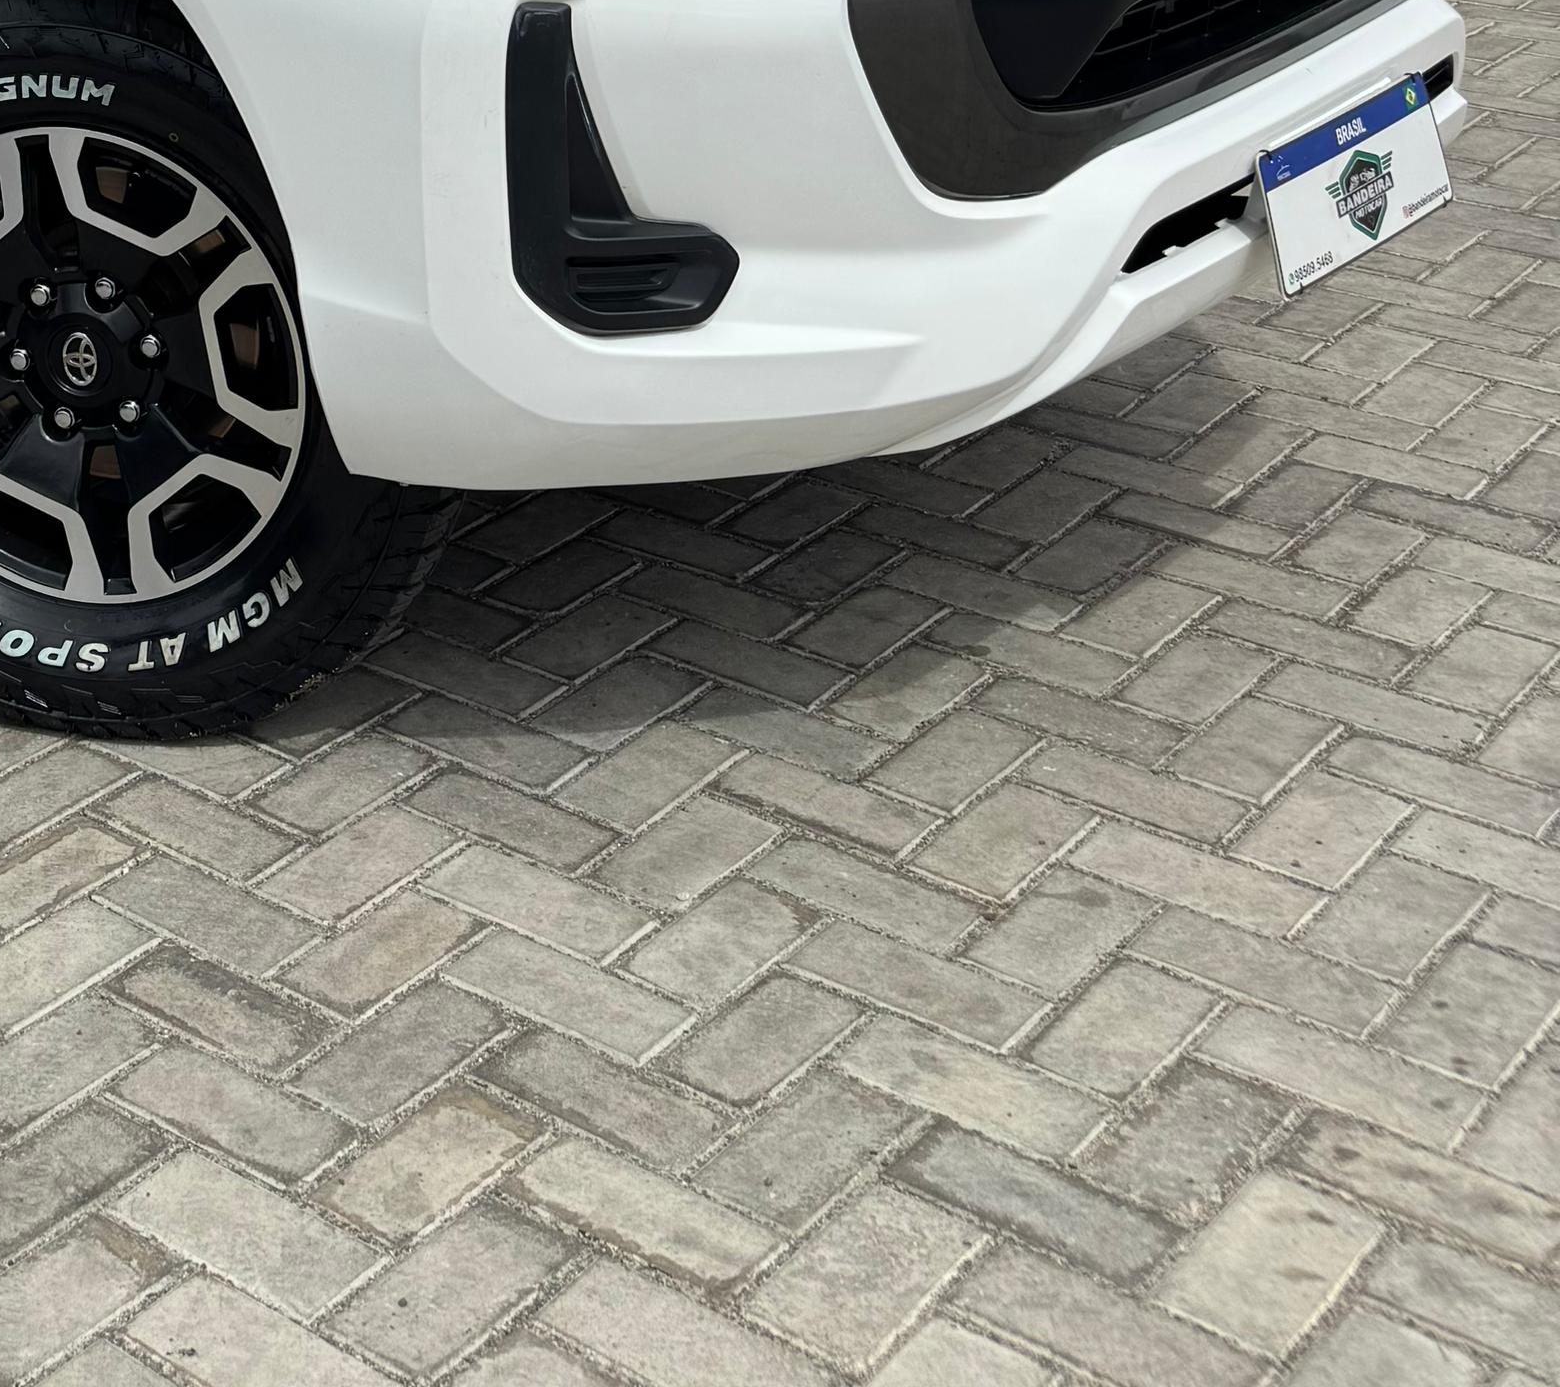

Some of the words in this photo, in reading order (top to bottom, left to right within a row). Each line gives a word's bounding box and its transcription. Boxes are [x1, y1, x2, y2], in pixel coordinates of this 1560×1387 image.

[1335, 117, 1366, 146] BRASIL
[1338, 174, 1392, 215] BANDEIRA
[206, 557, 304, 653] MGM
[128, 632, 188, 671] AT
